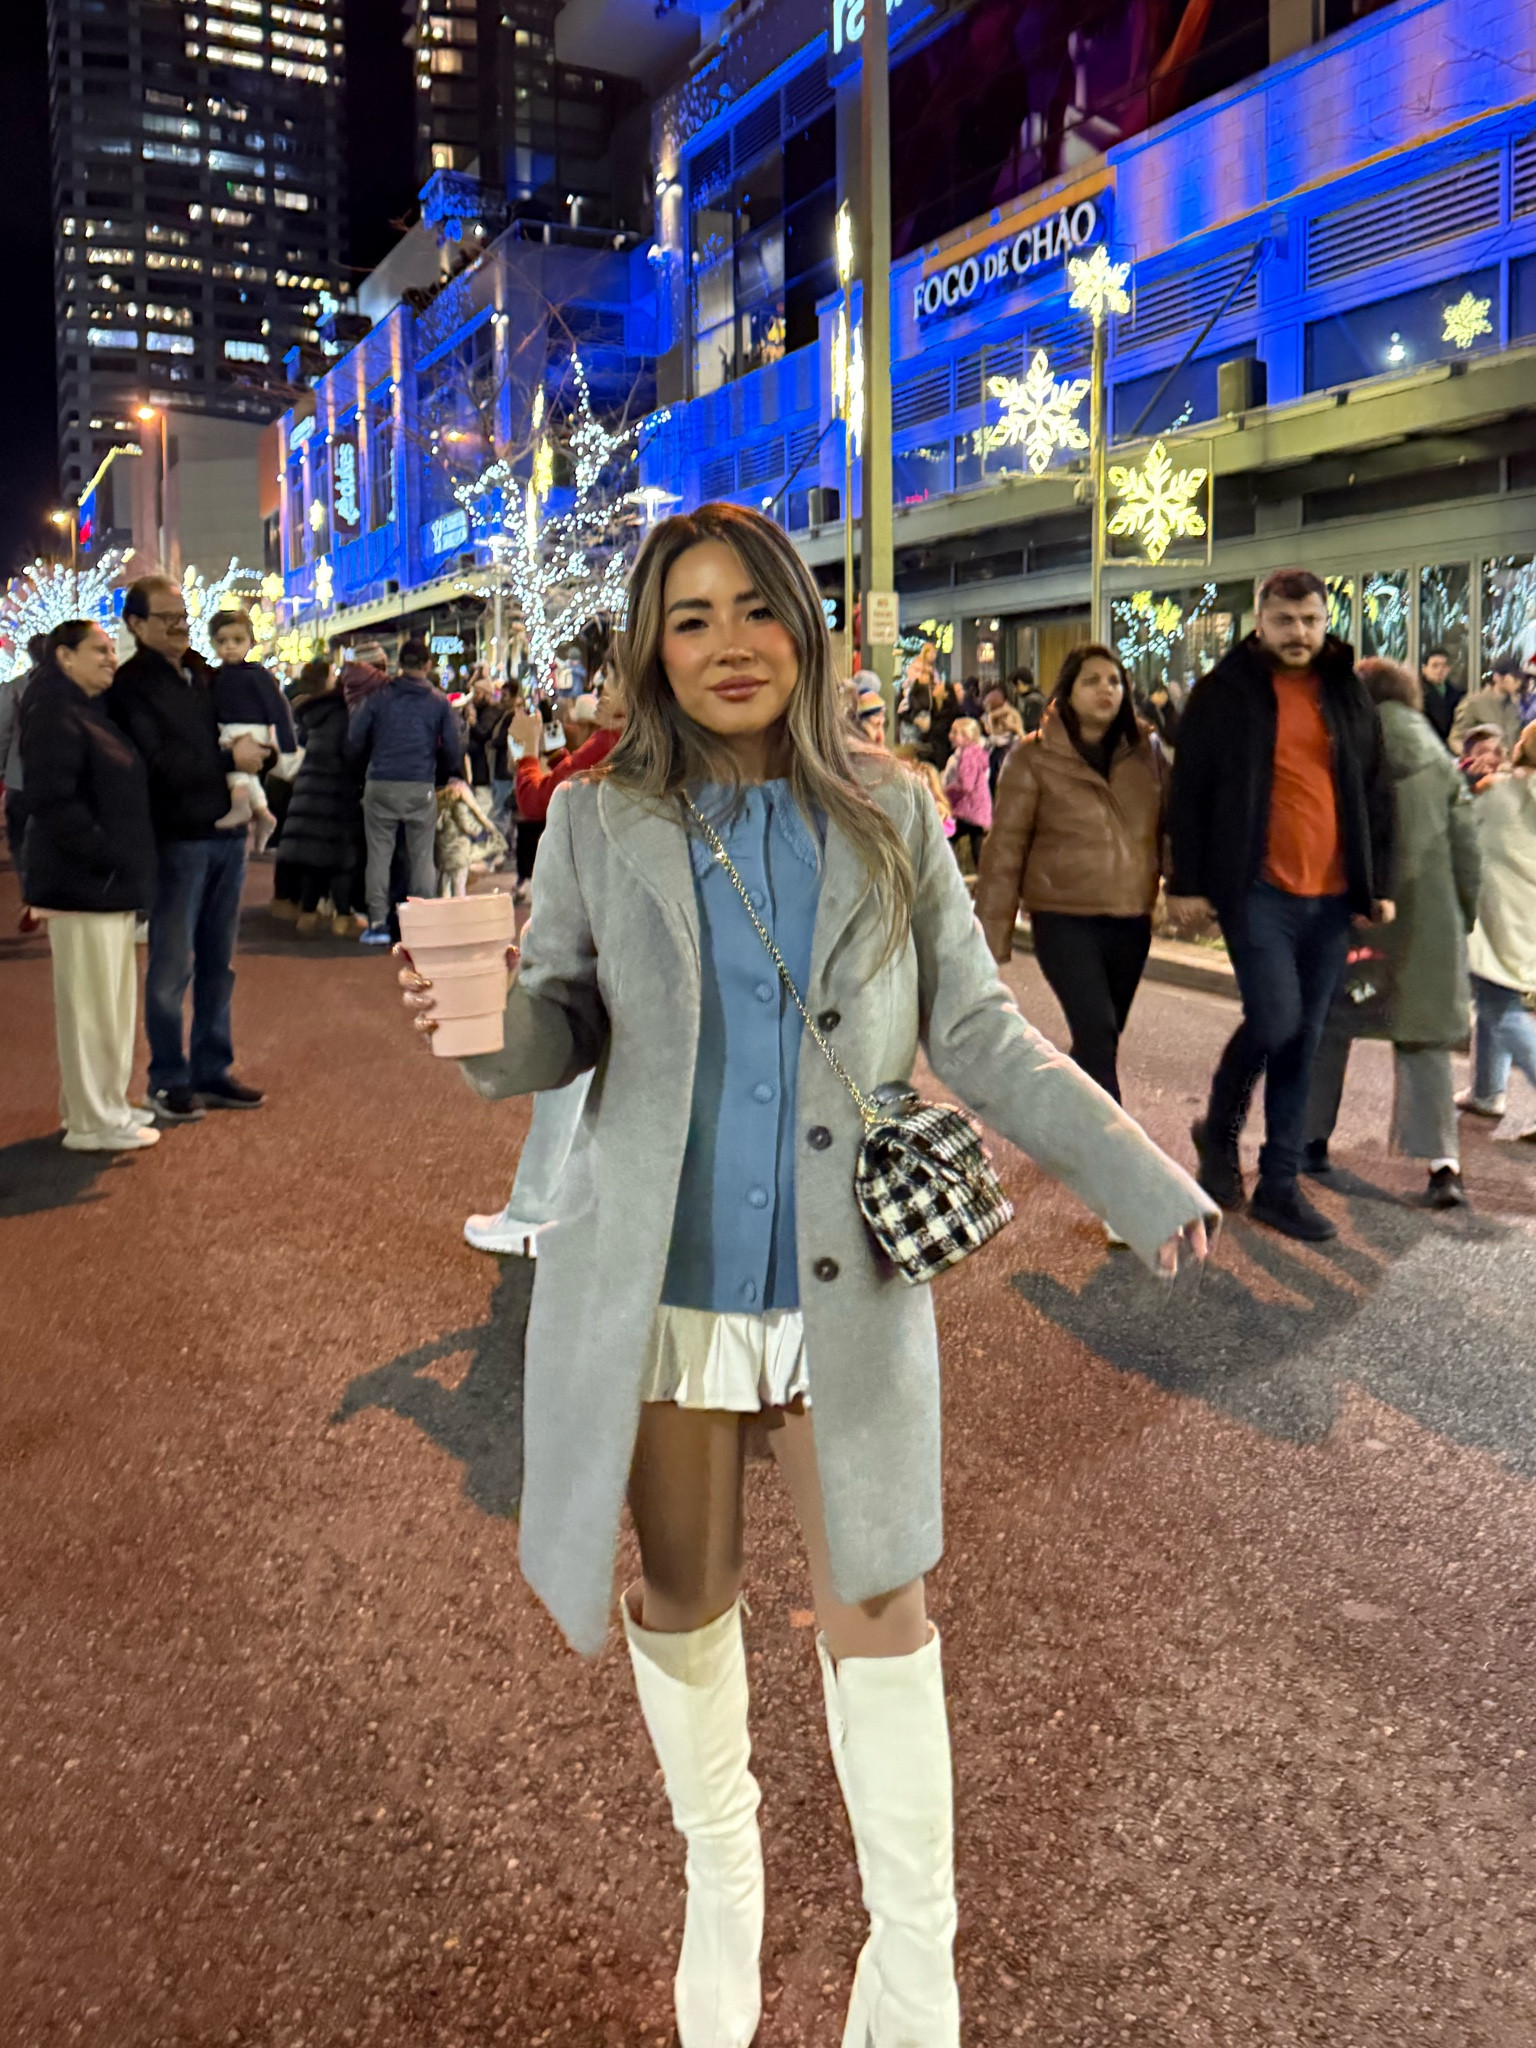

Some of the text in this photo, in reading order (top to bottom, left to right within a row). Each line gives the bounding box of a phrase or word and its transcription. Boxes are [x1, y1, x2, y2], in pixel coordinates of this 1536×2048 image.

[913, 200, 1096, 321] FOGO DE CHÃO
